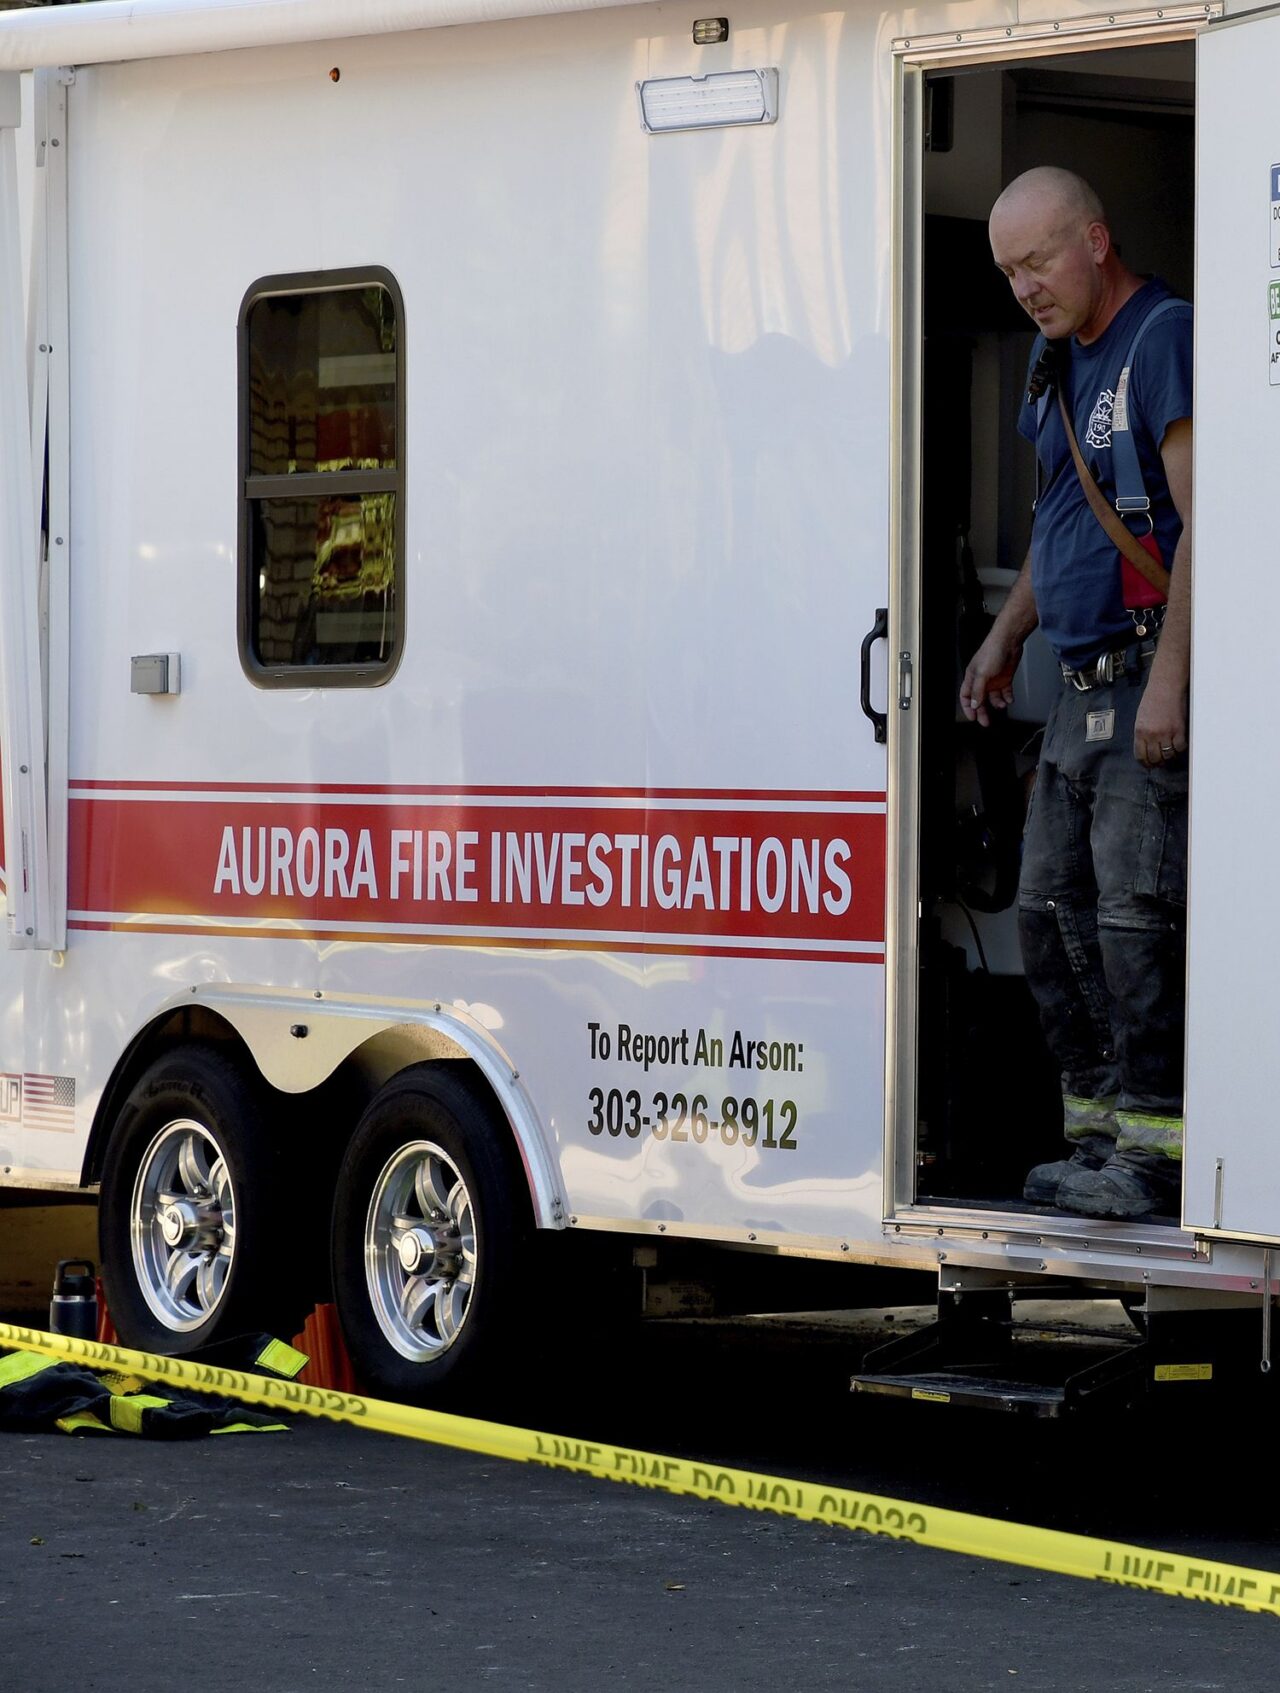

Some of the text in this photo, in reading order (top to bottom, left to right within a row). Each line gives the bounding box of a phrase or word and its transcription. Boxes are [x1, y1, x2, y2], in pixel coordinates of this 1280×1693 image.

[1270, 287, 1280, 315] BE
[213, 826, 853, 916] AURORA FIRE INVESTIGATIONS
[587, 1022, 803, 1072] To Report An Arson:
[587, 1087, 798, 1150] 303-326-8912
